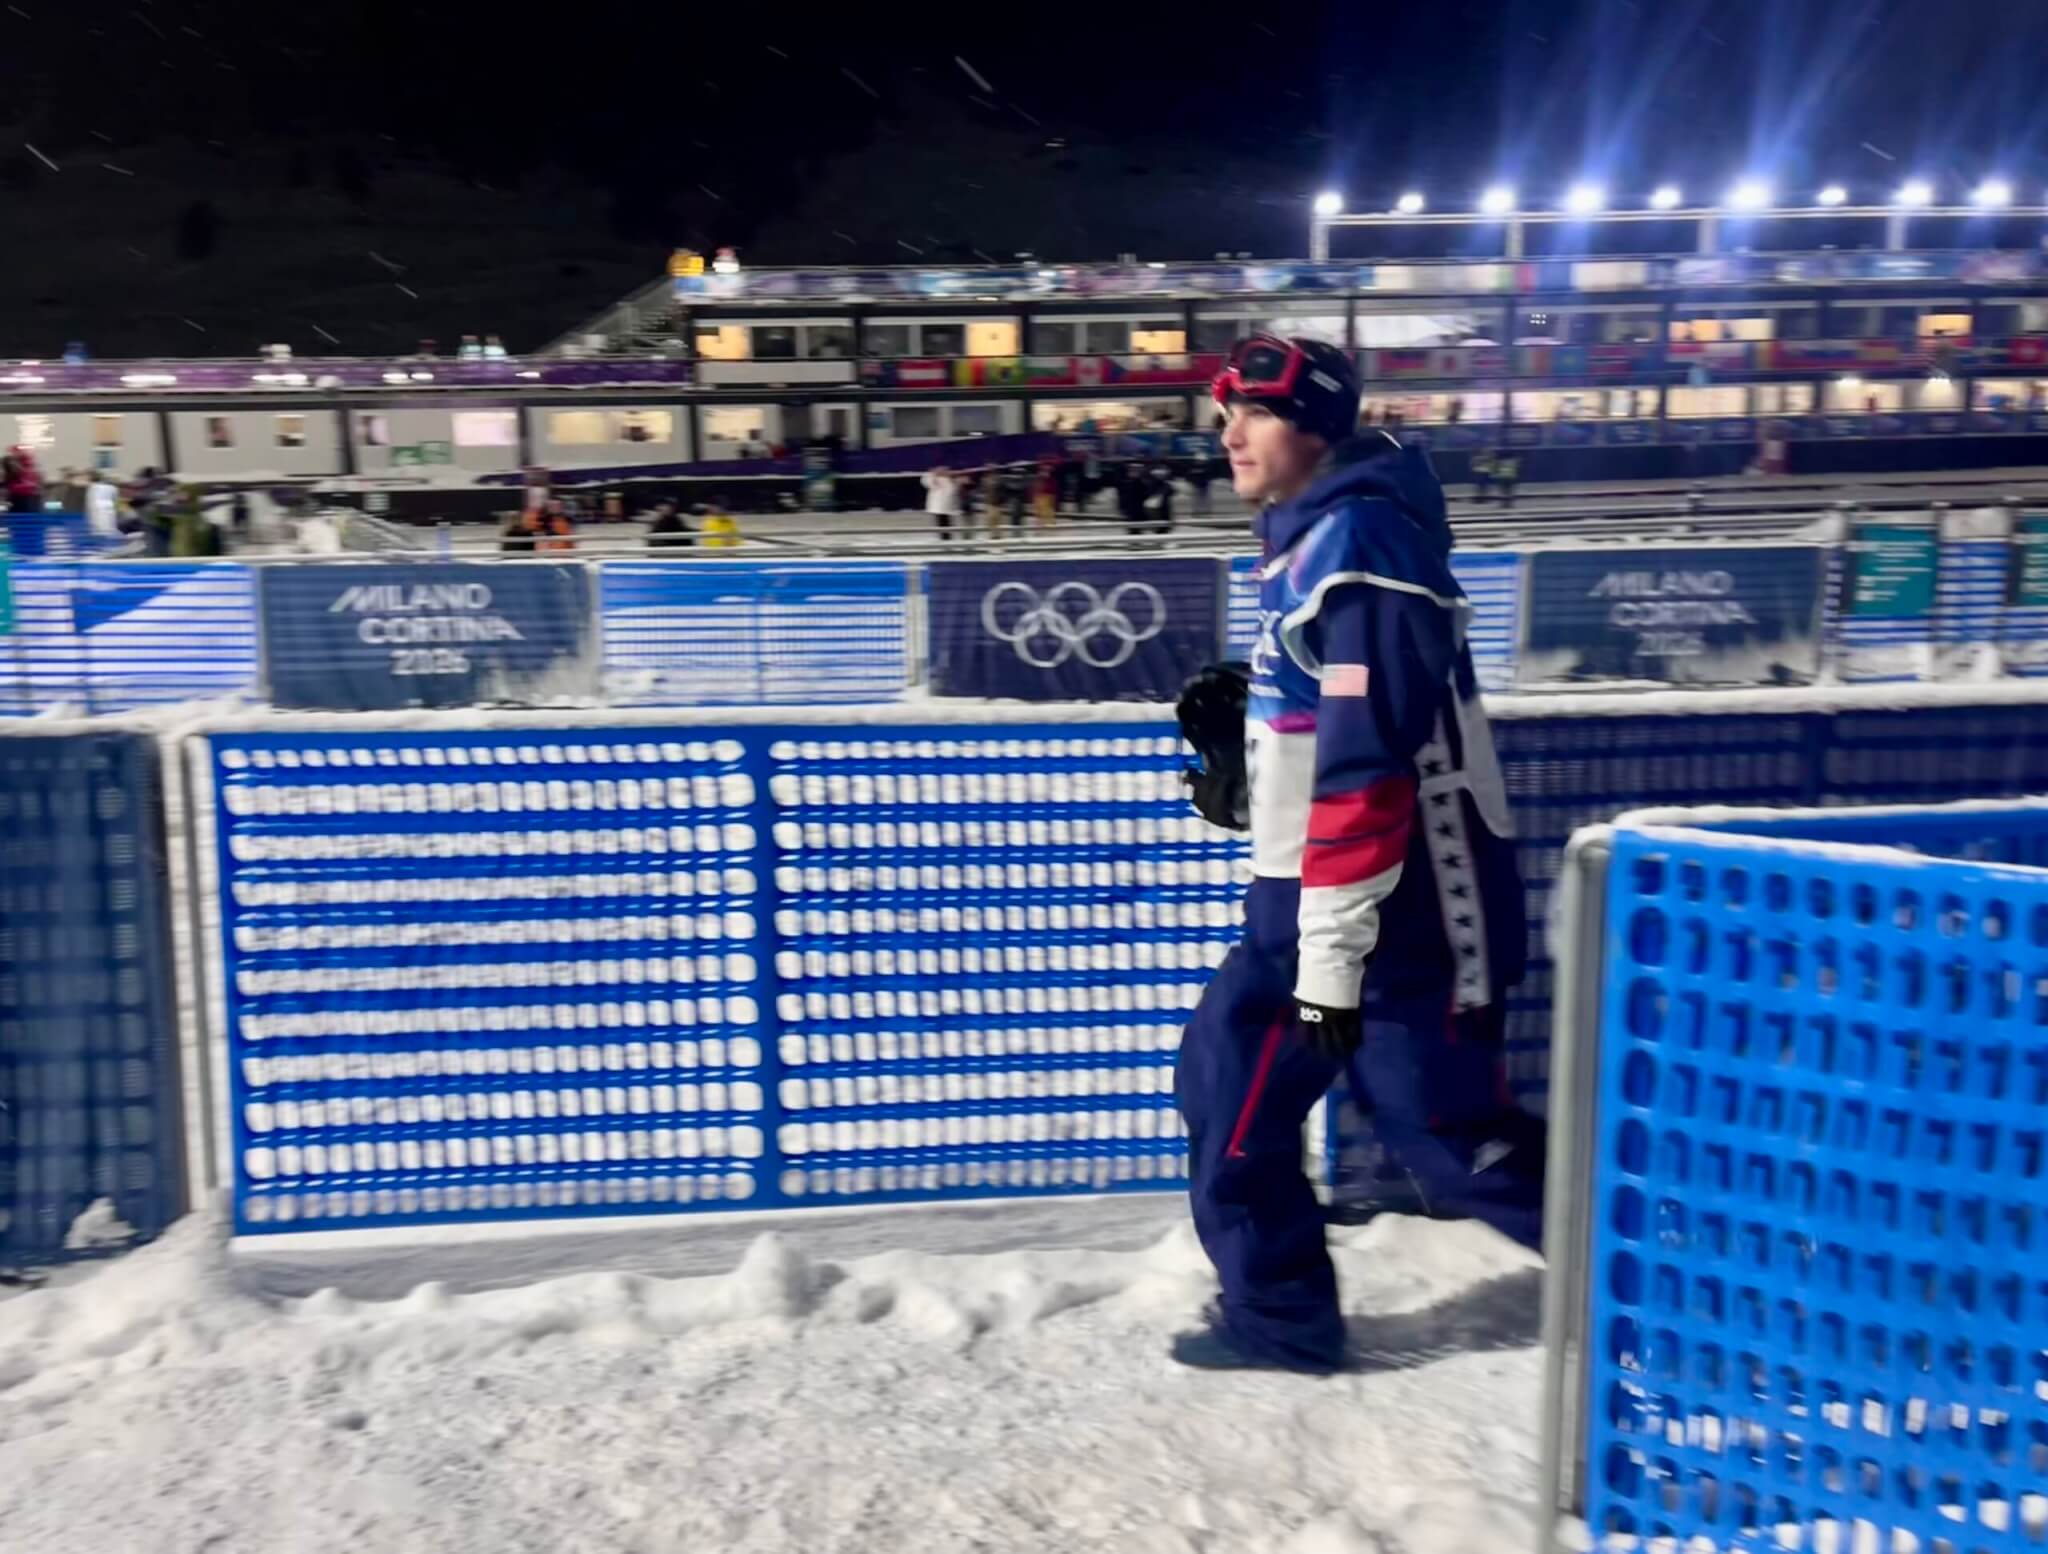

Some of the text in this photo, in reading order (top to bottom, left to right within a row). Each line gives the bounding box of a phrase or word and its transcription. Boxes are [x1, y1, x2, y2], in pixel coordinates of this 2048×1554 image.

[1586, 570, 1736, 596] MILANO
[327, 583, 493, 612] MILANO
[357, 616, 527, 644] CORTINA
